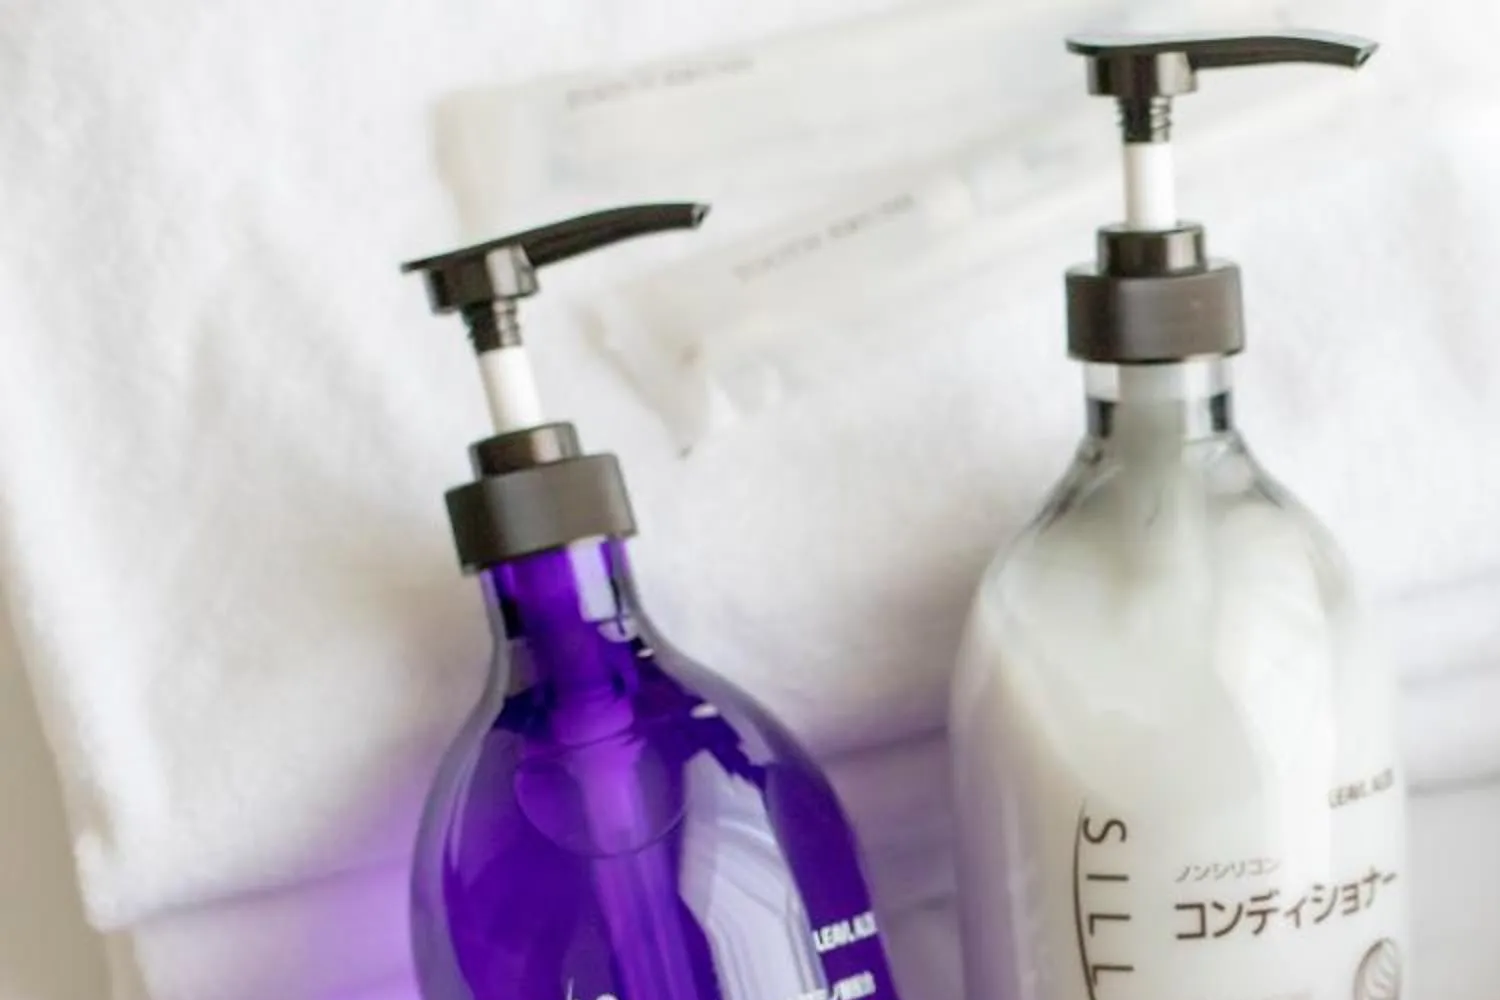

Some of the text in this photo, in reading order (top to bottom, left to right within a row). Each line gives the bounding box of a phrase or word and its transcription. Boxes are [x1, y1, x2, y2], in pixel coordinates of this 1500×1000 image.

[1175, 858, 1281, 883] ノンシリコン
[1174, 866, 1398, 941] コンディショナー
